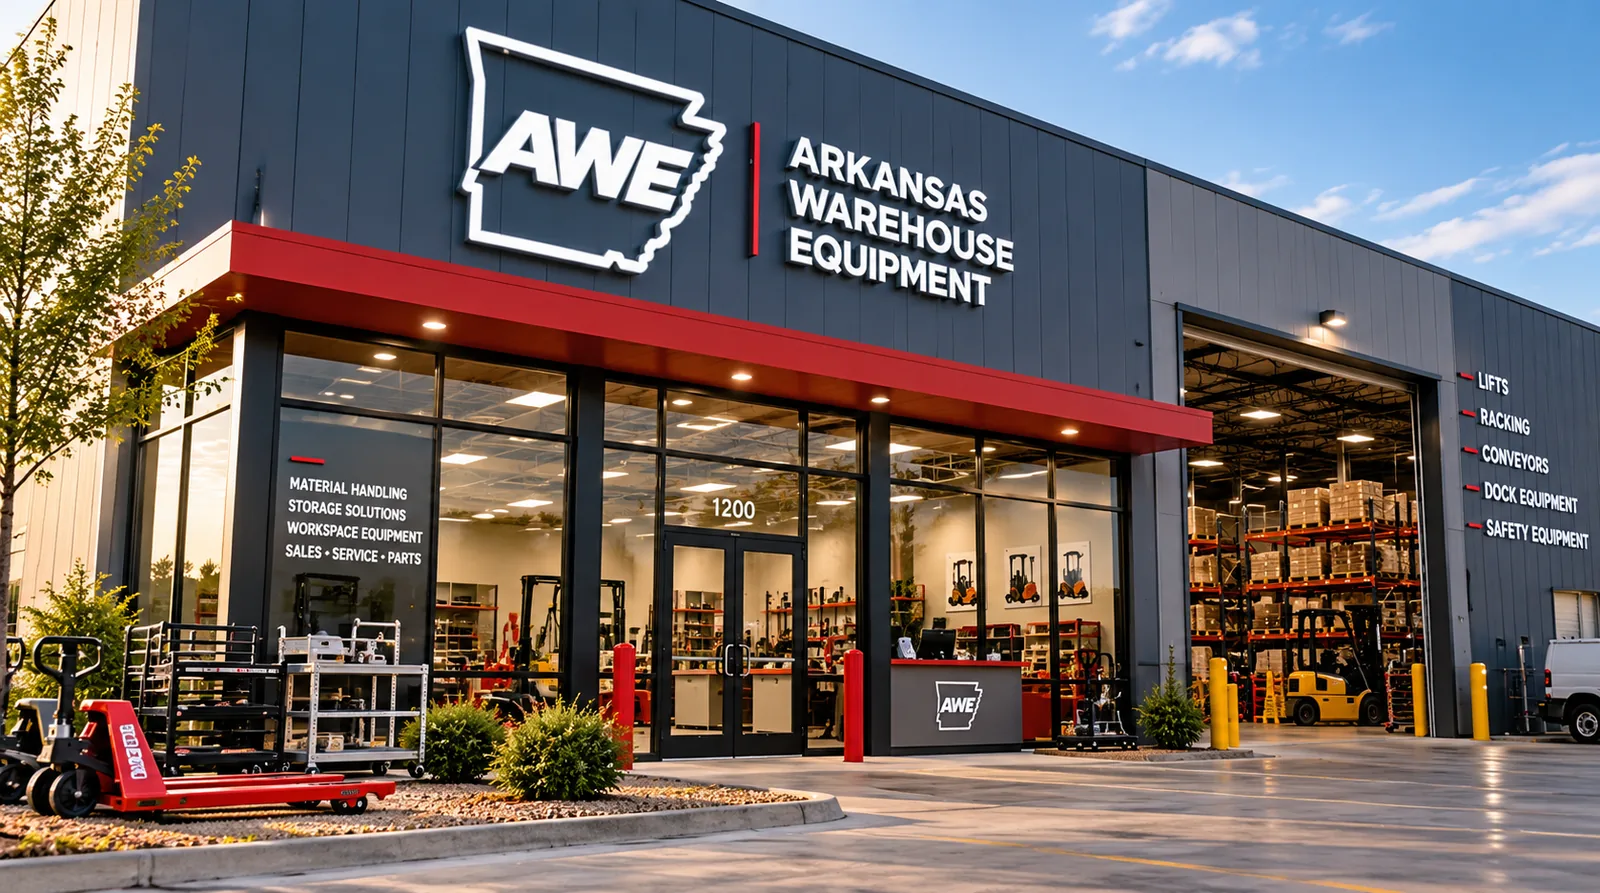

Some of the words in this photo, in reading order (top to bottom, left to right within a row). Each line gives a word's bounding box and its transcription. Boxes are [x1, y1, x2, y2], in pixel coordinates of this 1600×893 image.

[479, 110, 694, 212] AWE
[789, 135, 988, 223] ARKANSAS
[788, 179, 1015, 272] WAREHOUSE
[789, 227, 991, 307] EQUIPMENT
[1478, 372, 1509, 395] LIFTS
[1480, 408, 1531, 436] RACKING
[1482, 444, 1549, 474] CONVEYORS
[289, 476, 348, 495] MATERIAL
[351, 482, 408, 501] HANDLING
[1484, 481, 1518, 504] DOCK
[1520, 489, 1578, 514] EQUIPMENT
[288, 499, 342, 516] STORAGE
[345, 504, 407, 522] SOLUTIONS
[712, 497, 756, 519] 1200
[287, 521, 359, 539] WORKSPACE
[361, 526, 423, 544] EQUIPMENT
[1486, 519, 1530, 541] SAFETY
[1531, 526, 1590, 550] EQUIPMENT
[285, 544, 322, 559] SALES
[332, 547, 378, 563] SERVICE
[388, 551, 422, 565] PARTS
[940, 697, 976, 713] AWE
